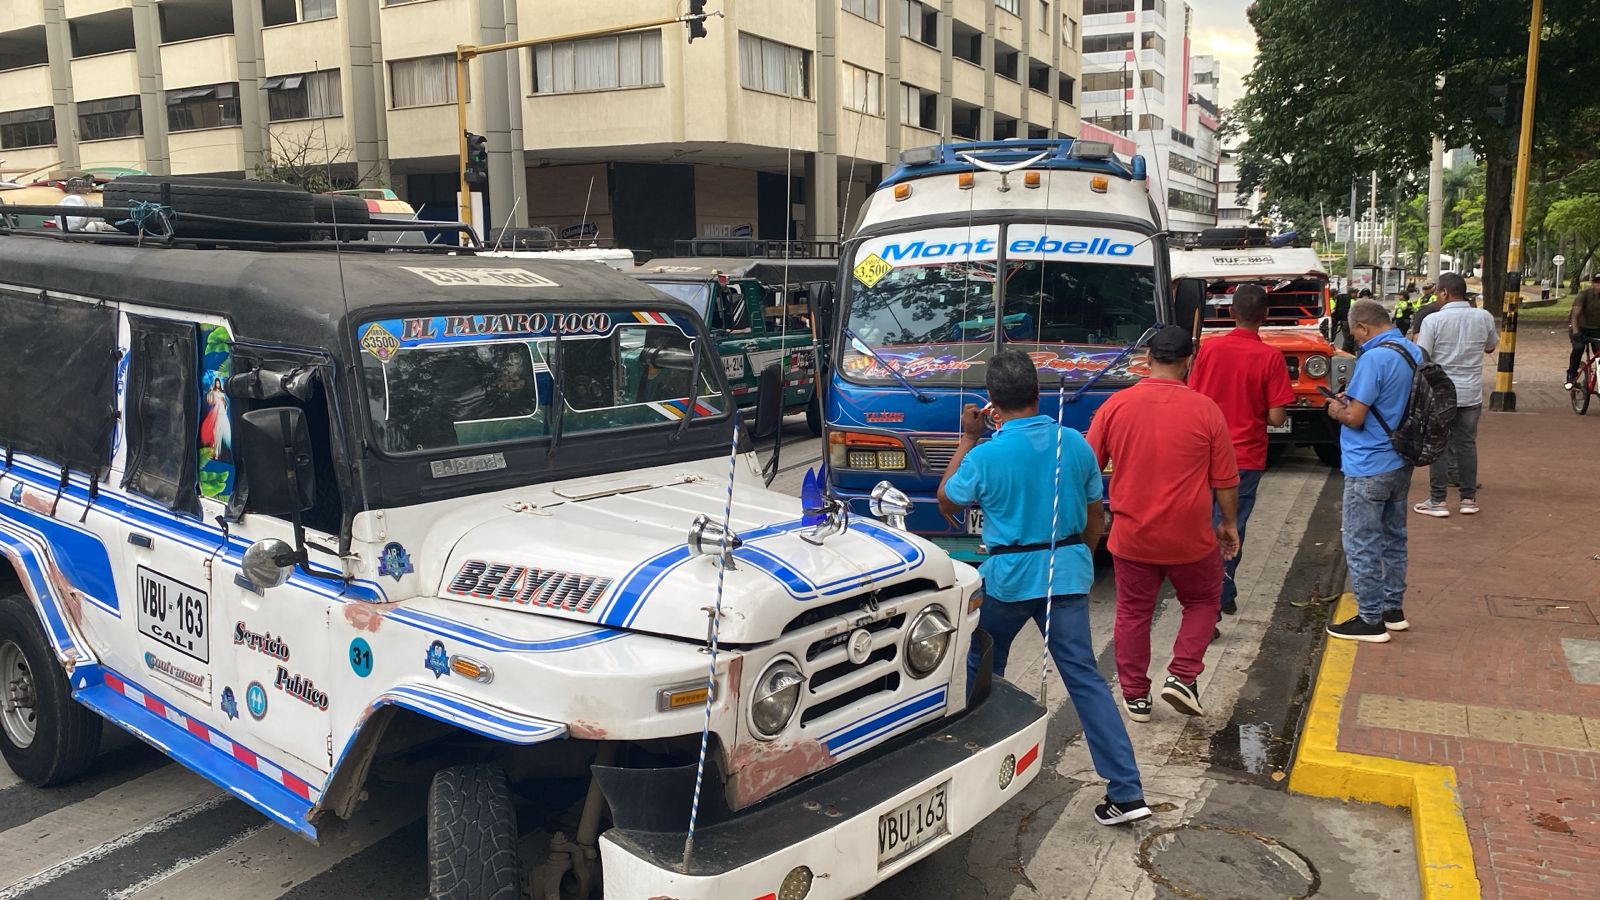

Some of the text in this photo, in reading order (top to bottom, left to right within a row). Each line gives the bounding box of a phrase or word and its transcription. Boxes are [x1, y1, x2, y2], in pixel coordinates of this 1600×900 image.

[881, 236, 1135, 260] Mont ebello
[363, 336, 395, 348] $3500
[401, 312, 612, 341] EL PAJARO LOCO
[447, 560, 615, 613] BELYINI
[141, 576, 203, 638] VBU 163
[151, 625, 193, 651] CALI
[234, 621, 290, 662] Servicio
[353, 646, 370, 669] 31
[274, 665, 329, 711] Publico
[878, 790, 945, 854] VBU 163
